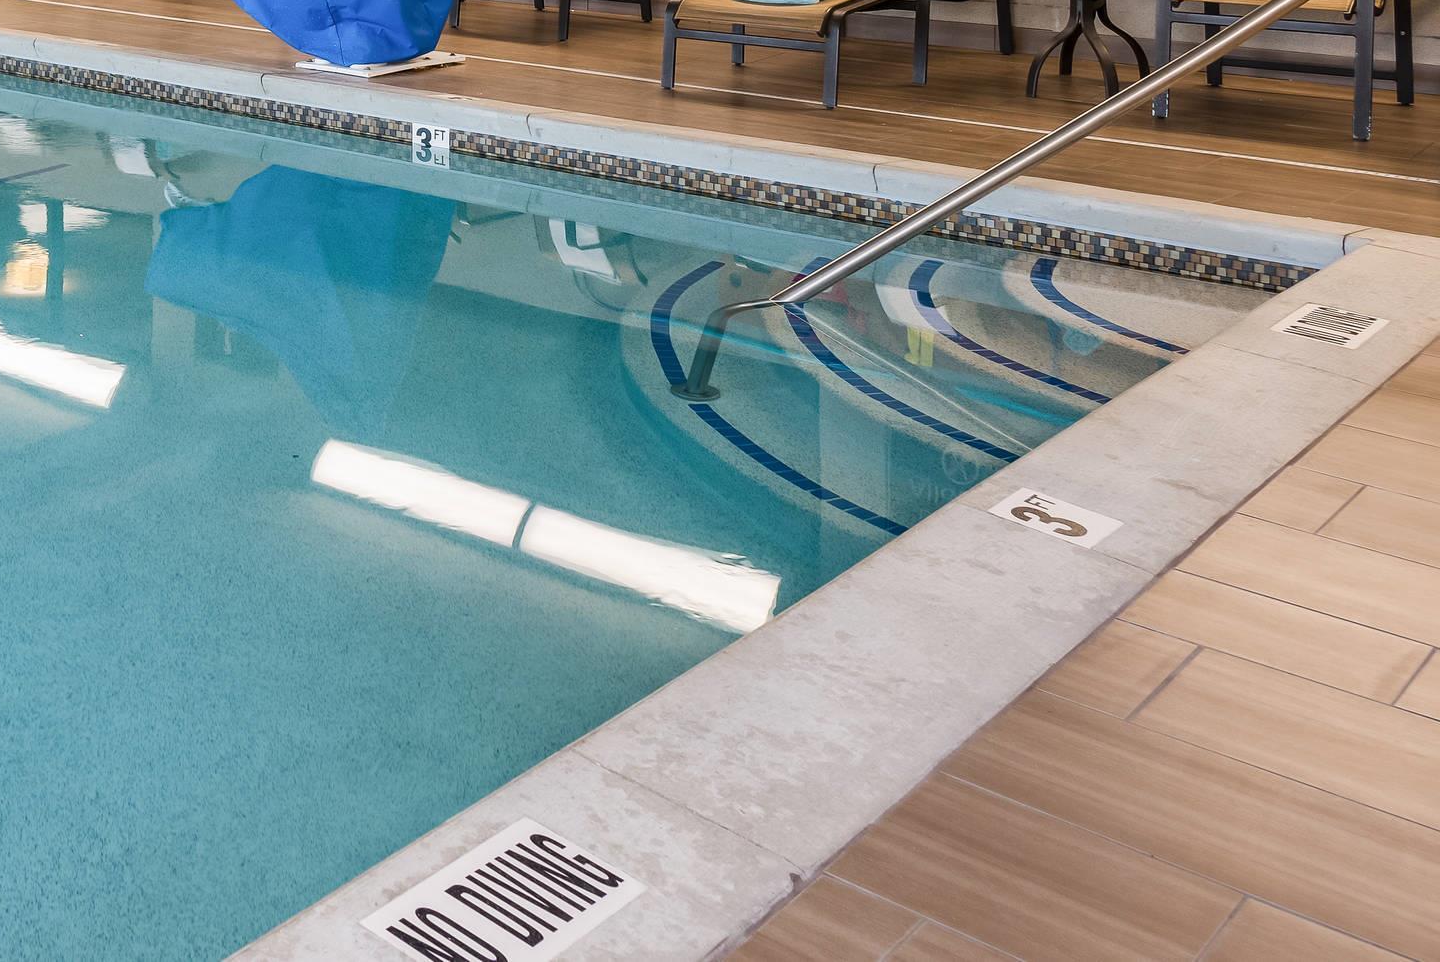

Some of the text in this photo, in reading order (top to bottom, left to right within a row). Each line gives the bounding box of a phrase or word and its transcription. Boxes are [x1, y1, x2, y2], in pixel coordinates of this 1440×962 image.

[416, 127, 446, 149] 3 FT
[1297, 307, 1377, 336] DIVING
[1010, 494, 1088, 538] 3 FT
[444, 833, 625, 948] DIVING
